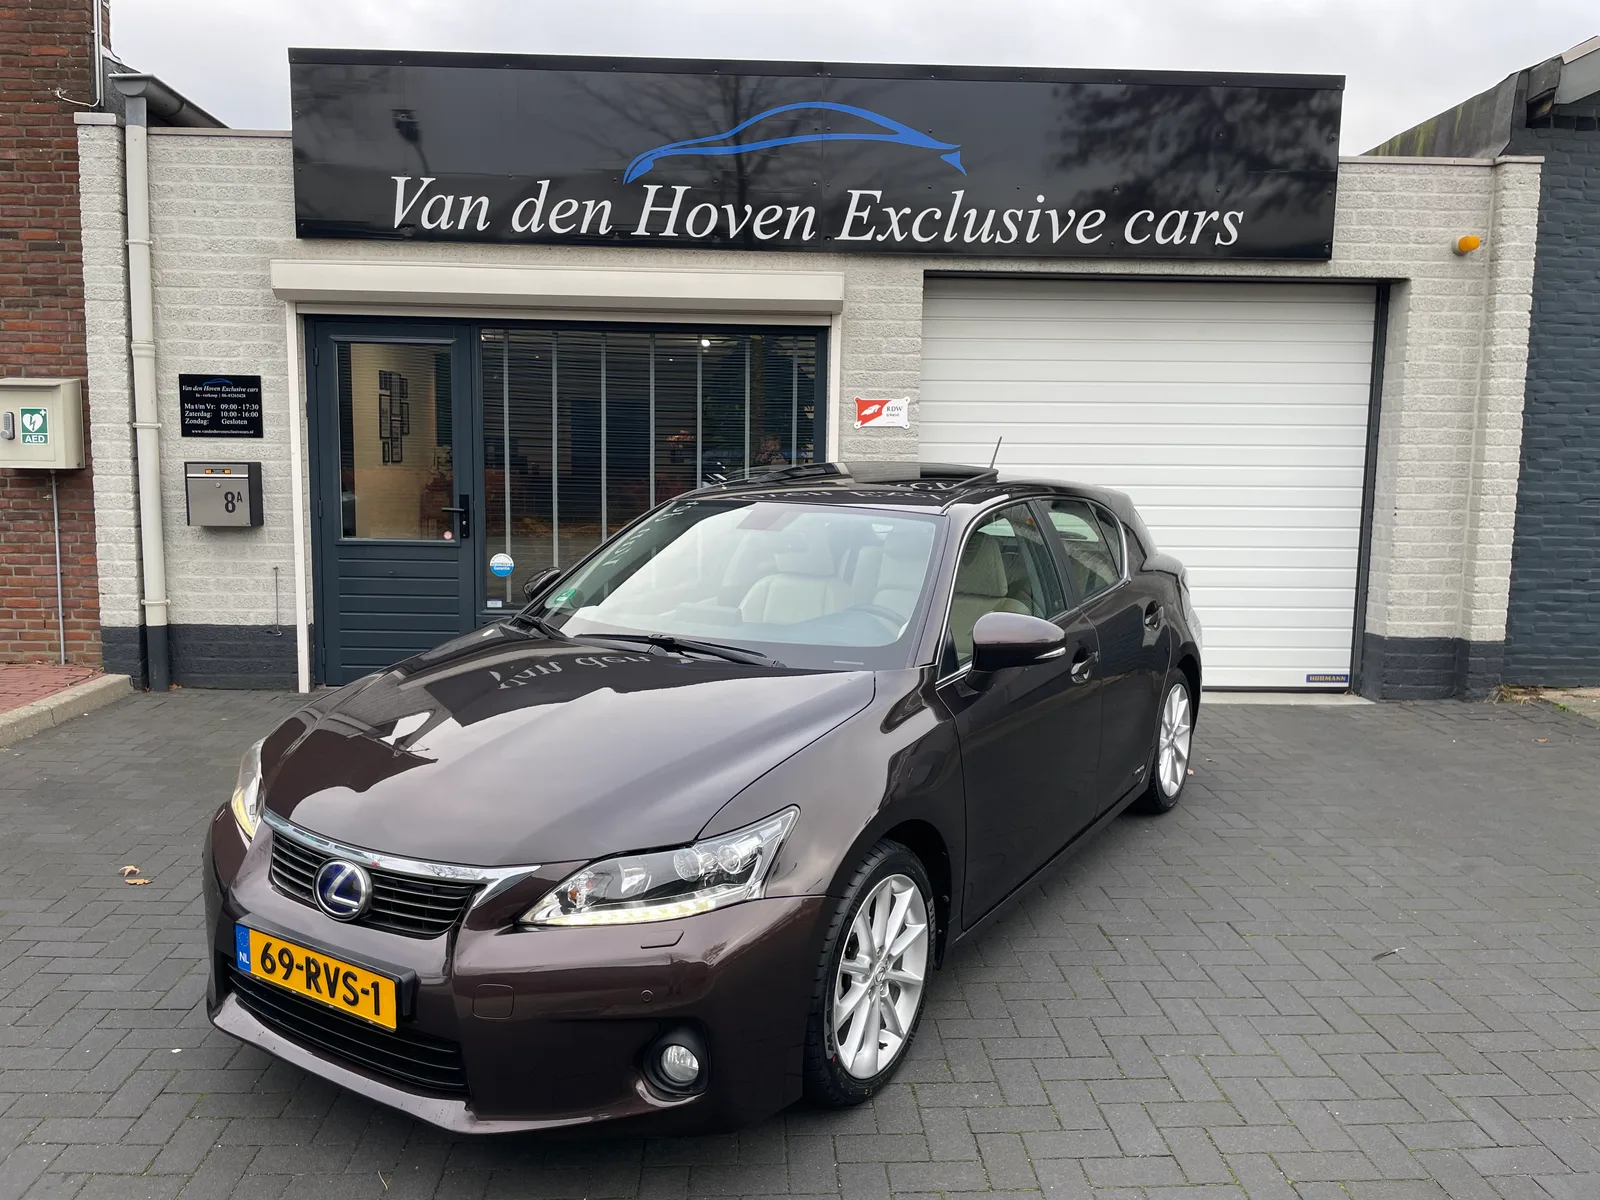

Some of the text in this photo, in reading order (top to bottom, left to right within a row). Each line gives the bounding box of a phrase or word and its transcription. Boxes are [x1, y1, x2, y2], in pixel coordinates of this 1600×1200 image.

[390, 175, 1245, 247] Van den Hoven Exclusive cars
[221, 385, 246, 393] Exclusive
[242, 403, 259, 411] 17:30
[184, 410, 213, 418] Zaterdag:
[184, 418, 210, 426] Zondag:
[25, 435, 46, 443] AED
[239, 950, 250, 965] NL
[260, 941, 381, 1017] 69-RVS-1
